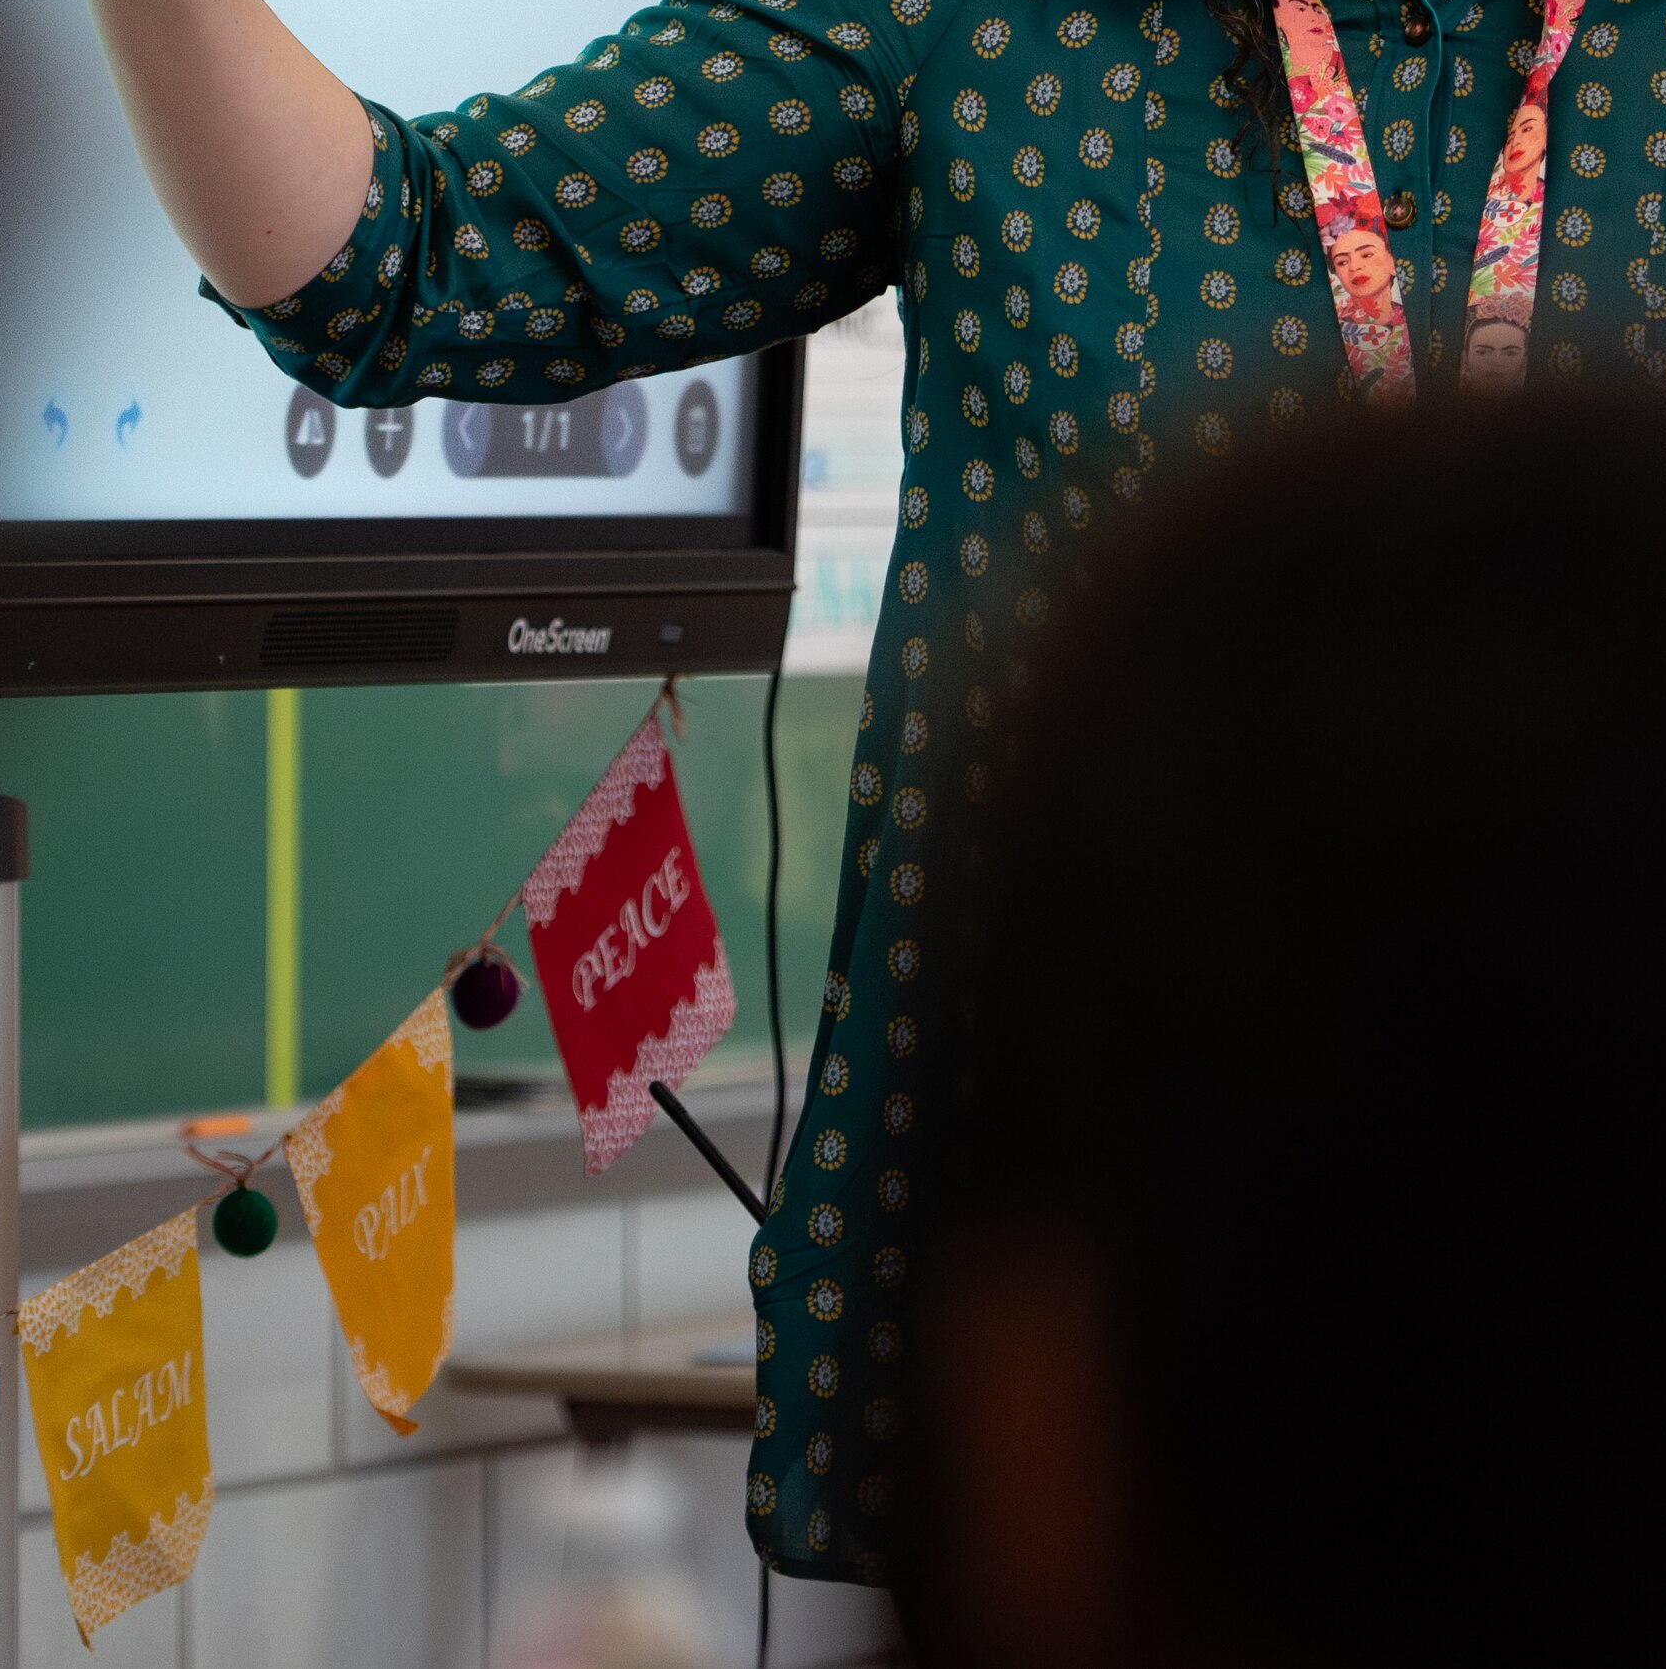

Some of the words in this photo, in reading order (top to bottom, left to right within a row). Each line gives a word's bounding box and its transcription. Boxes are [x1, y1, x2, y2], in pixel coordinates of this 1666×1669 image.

[522, 410, 571, 453] 1/1
[507, 617, 612, 654] OneScreen
[571, 846, 691, 1012] PEACE
[352, 1146, 434, 1263] PAIX
[58, 1349, 193, 1483] SALAM
